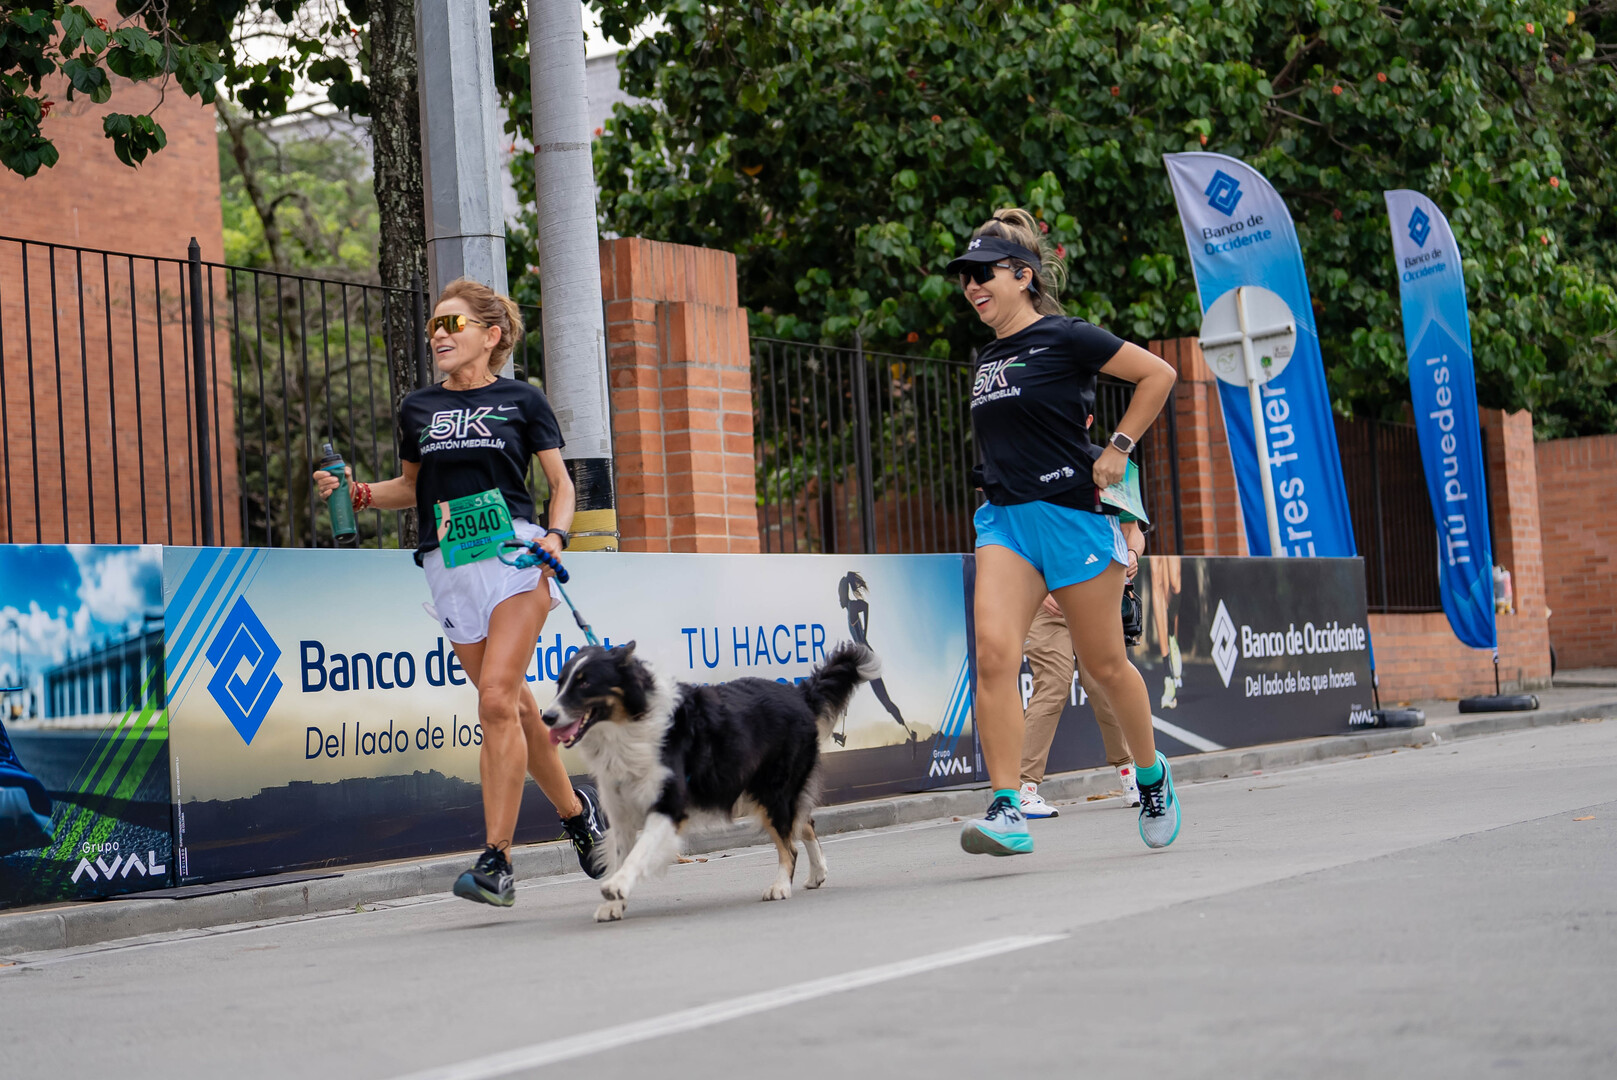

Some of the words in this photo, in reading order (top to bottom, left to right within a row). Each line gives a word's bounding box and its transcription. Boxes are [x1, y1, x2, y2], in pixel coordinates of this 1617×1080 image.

[1202, 221, 1244, 240] Banco
[1246, 214, 1264, 228] de
[1204, 229, 1272, 256] Occidente
[1404, 253, 1430, 269] Banco
[1431, 248, 1442, 260] de
[973, 356, 1019, 397] 5K
[429, 406, 494, 440] 5K
[1260, 384, 1299, 468] fuer
[1426, 354, 1468, 502] puedes!
[420, 439, 460, 456] MARATÓN
[460, 438, 506, 450] MEDELLÍN
[444, 508, 501, 543] 25940
[460, 536, 493, 550] ELIZABETH
[681, 627, 720, 669] TU
[732, 623, 827, 667] HACER
[1241, 624, 1285, 659] Banco
[1286, 622, 1304, 656] de
[1303, 620, 1366, 655] Occidente
[300, 640, 416, 693] Banco
[425, 636, 467, 687] de
[1245, 674, 1262, 698] Del
[1262, 672, 1284, 696] lado
[1284, 670, 1297, 694] de
[1297, 670, 1311, 692] los
[1311, 674, 1329, 696] que
[1329, 667, 1357, 689] hacen.
[1348, 709, 1374, 726] AVAL
[305, 722, 346, 760] Del
[355, 719, 409, 756] lado
[415, 716, 445, 751] de
[452, 714, 484, 748] los
[928, 756, 972, 778] AVAL
[932, 749, 951, 759] Grupo
[82, 841, 120, 854] Grupo
[70, 850, 166, 884] AVAL
